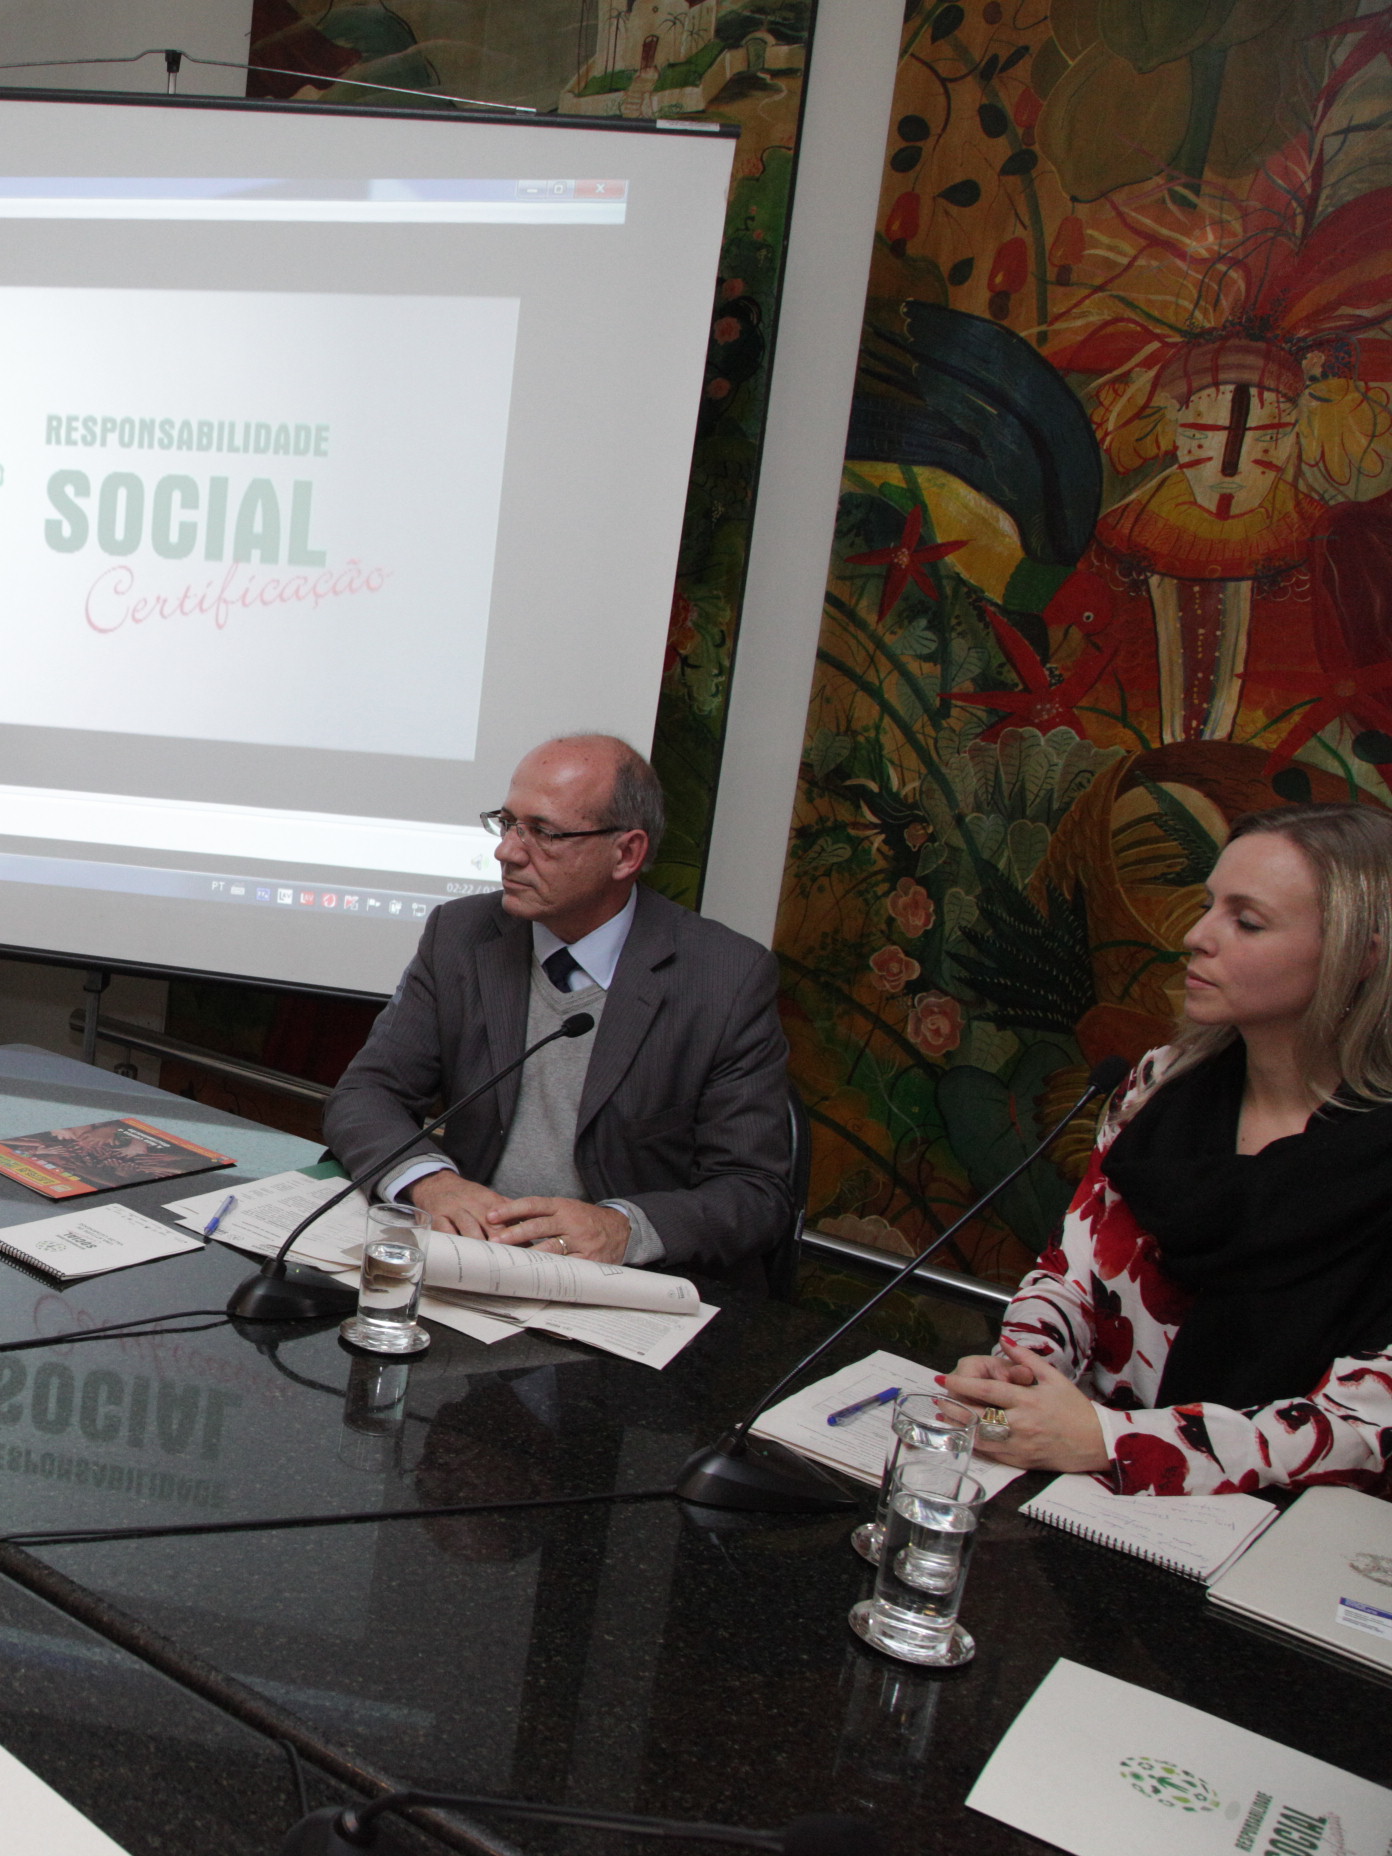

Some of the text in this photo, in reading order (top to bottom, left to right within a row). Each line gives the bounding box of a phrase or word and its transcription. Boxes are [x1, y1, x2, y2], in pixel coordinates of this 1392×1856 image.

[45, 413, 330, 457] RESPONSABILIDADE
[44, 468, 327, 568] SOCIAL
[85, 558, 395, 634] Certificação
[211, 881, 226, 892] PT
[446, 883, 474, 894] 02:22
[1235, 1790, 1273, 1852] RESPONSABILIDADE
[1264, 1805, 1327, 1856] OCIAL
